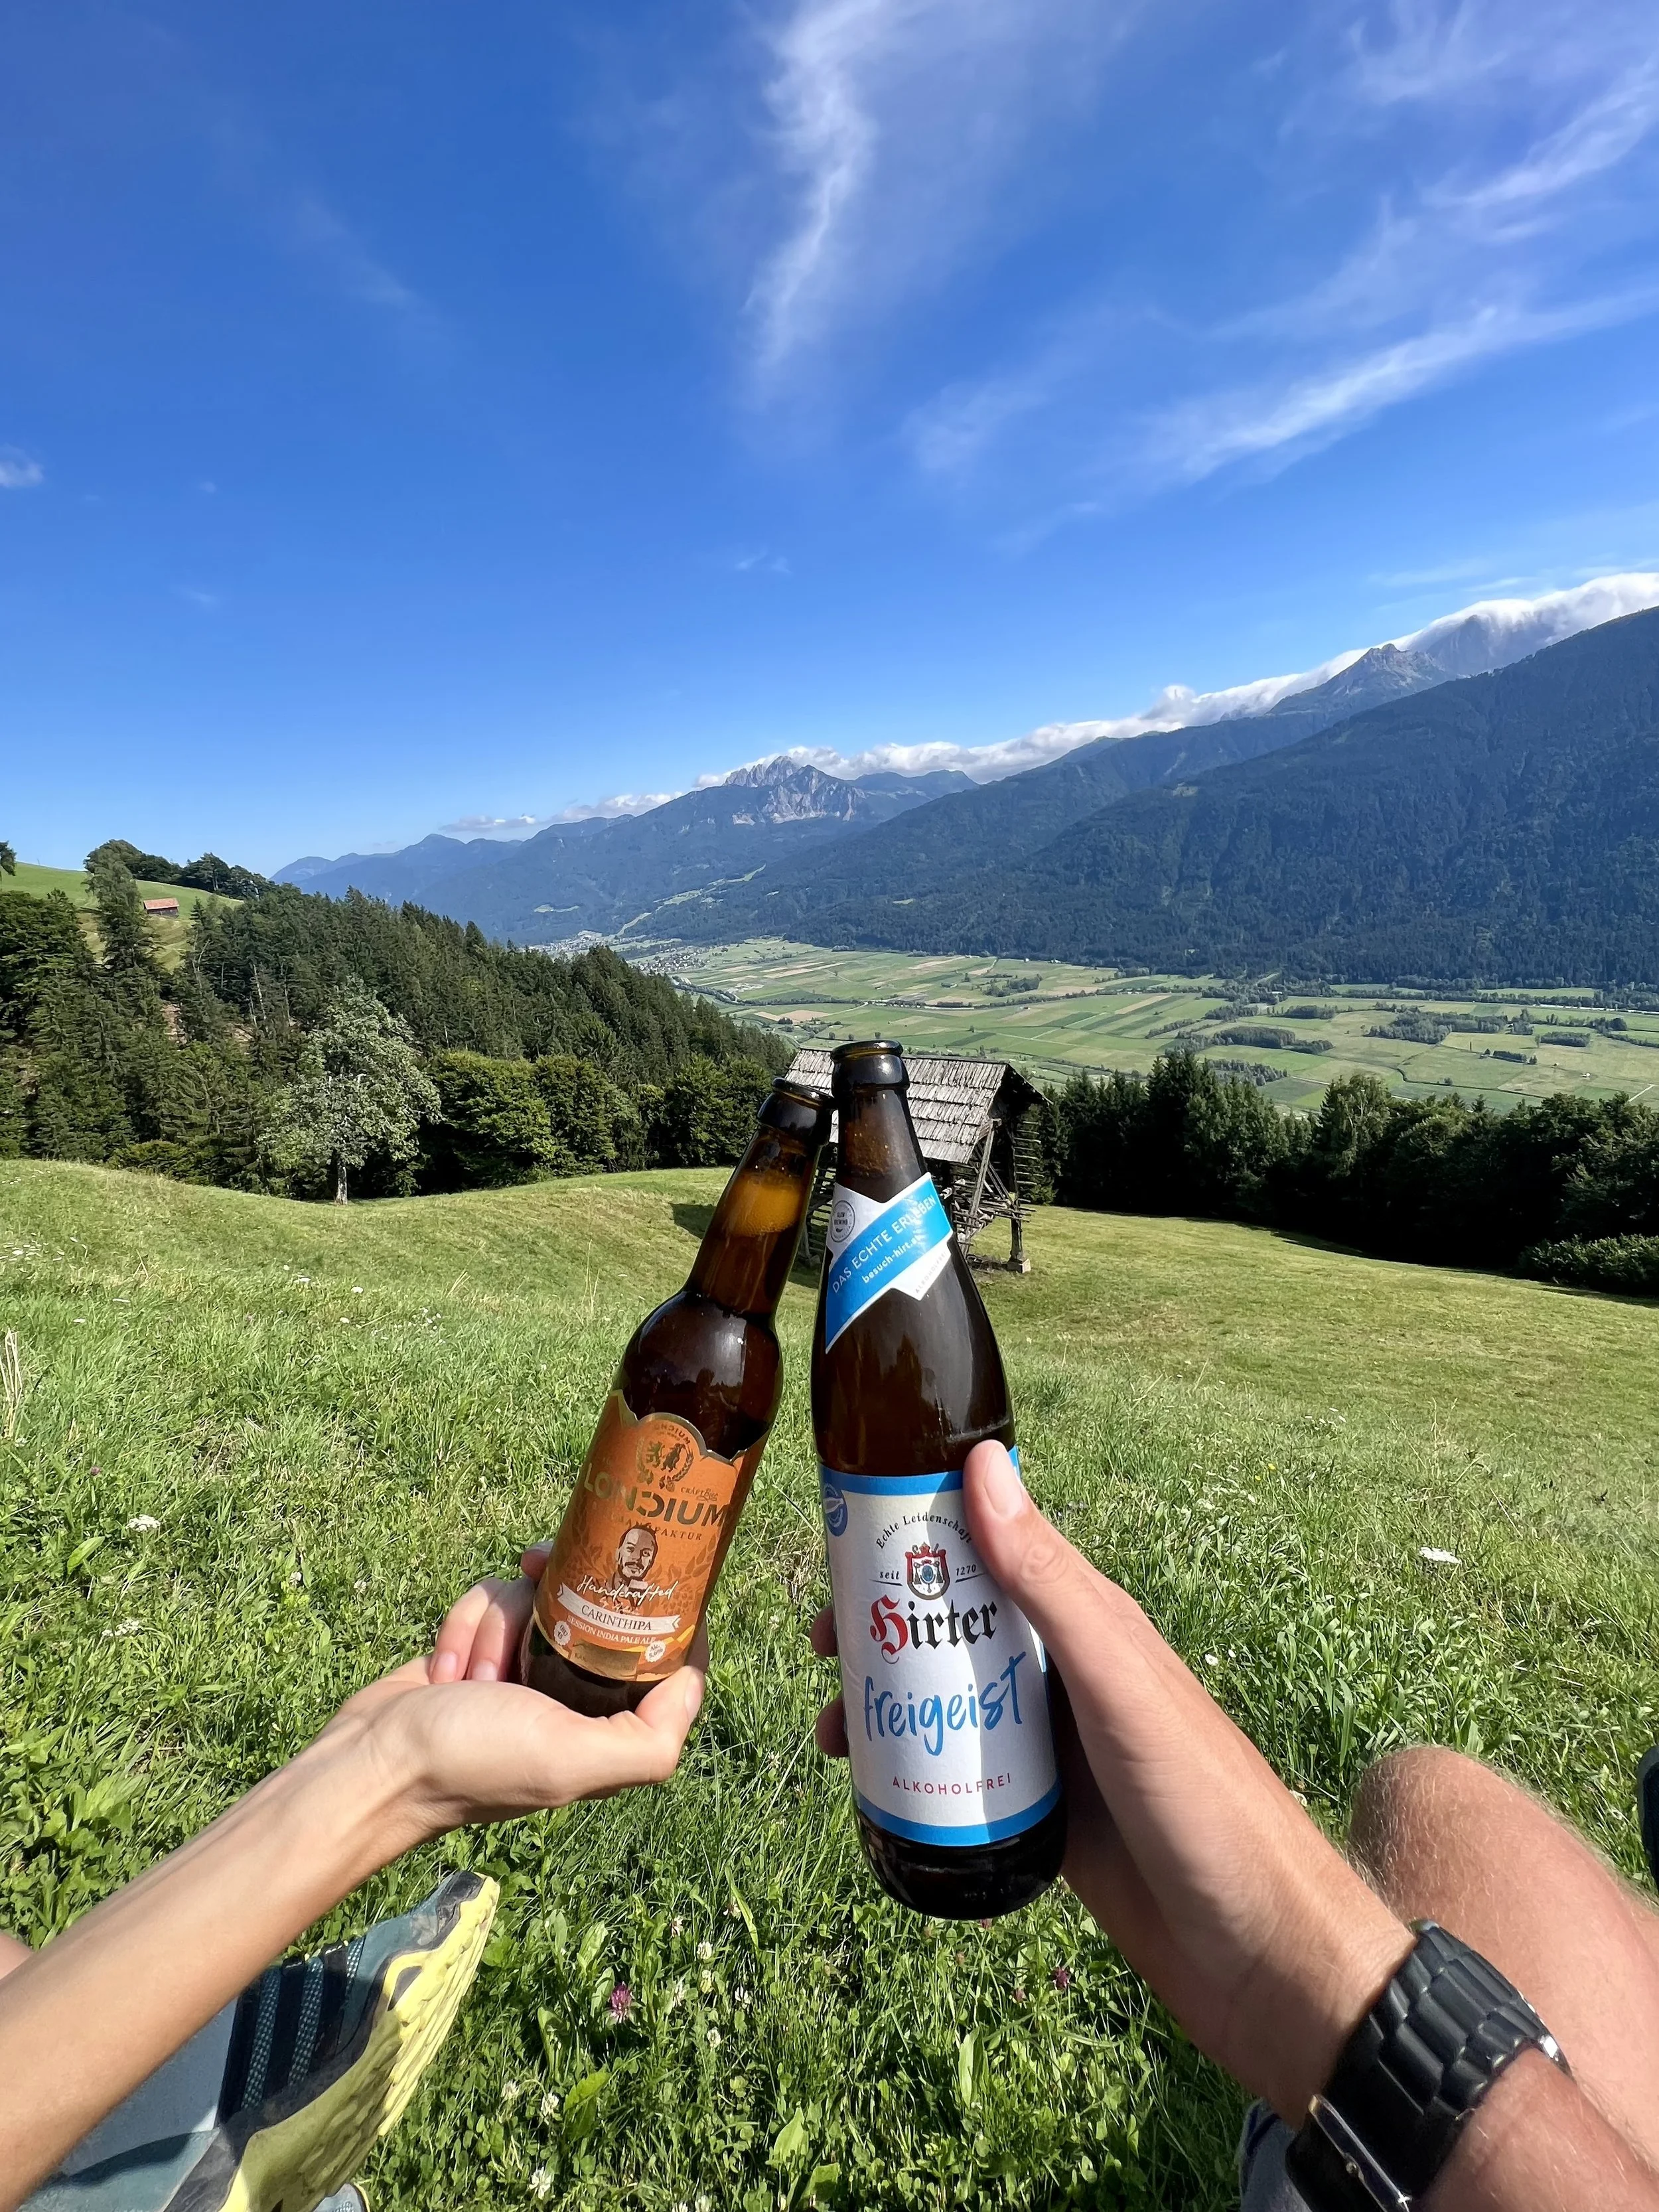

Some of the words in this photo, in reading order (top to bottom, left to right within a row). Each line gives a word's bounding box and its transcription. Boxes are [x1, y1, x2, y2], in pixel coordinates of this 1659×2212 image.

[832, 1267, 852, 1293] DAS
[851, 1229, 893, 1269] ECHTE
[875, 1522, 901, 1550] Echte
[879, 1570, 900, 1580] seit
[956, 1564, 977, 1576] 1270
[576, 1574, 680, 1607] Handcrafted
[567, 1615, 597, 1637] SESSION
[597, 1629, 620, 1643] INDIA
[620, 1635, 641, 1645] PALE
[640, 1637, 656, 1646] ALE
[581, 1604, 652, 1631] CARINTHIPA
[869, 1595, 997, 1664] Hirter
[863, 1651, 1026, 1756] freigeist
[893, 1773, 1011, 1795] ALKOHOLFREI
